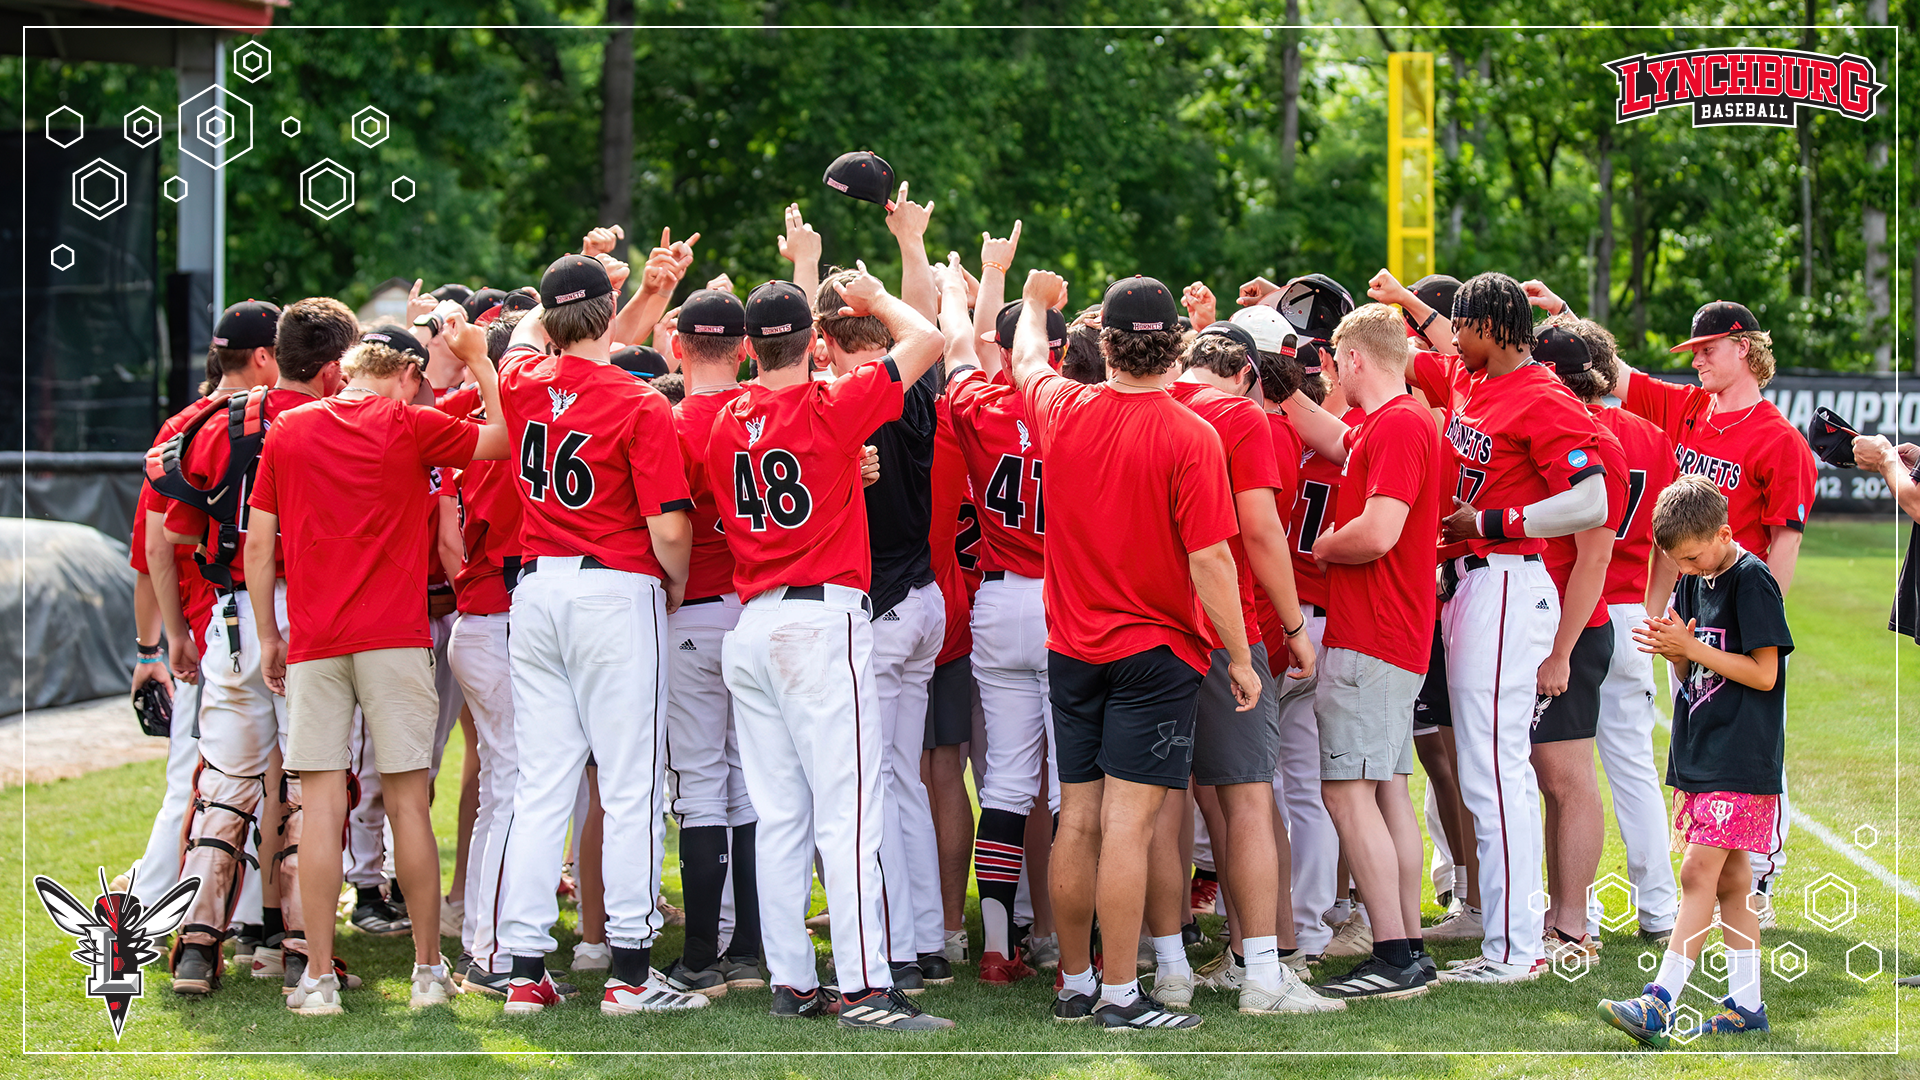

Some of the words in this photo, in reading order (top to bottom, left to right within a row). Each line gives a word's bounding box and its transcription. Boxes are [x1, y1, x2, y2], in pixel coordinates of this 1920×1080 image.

[555, 289, 586, 305] HORNETS
[694, 324, 725, 334] HORNETS
[761, 323, 792, 335] HORNETS
[1132, 321, 1164, 331] HORNETS
[519, 420, 595, 510] 46
[733, 449, 812, 532] 48
[1456, 463, 1486, 504] 17
[1815, 476, 1842, 498] 12
